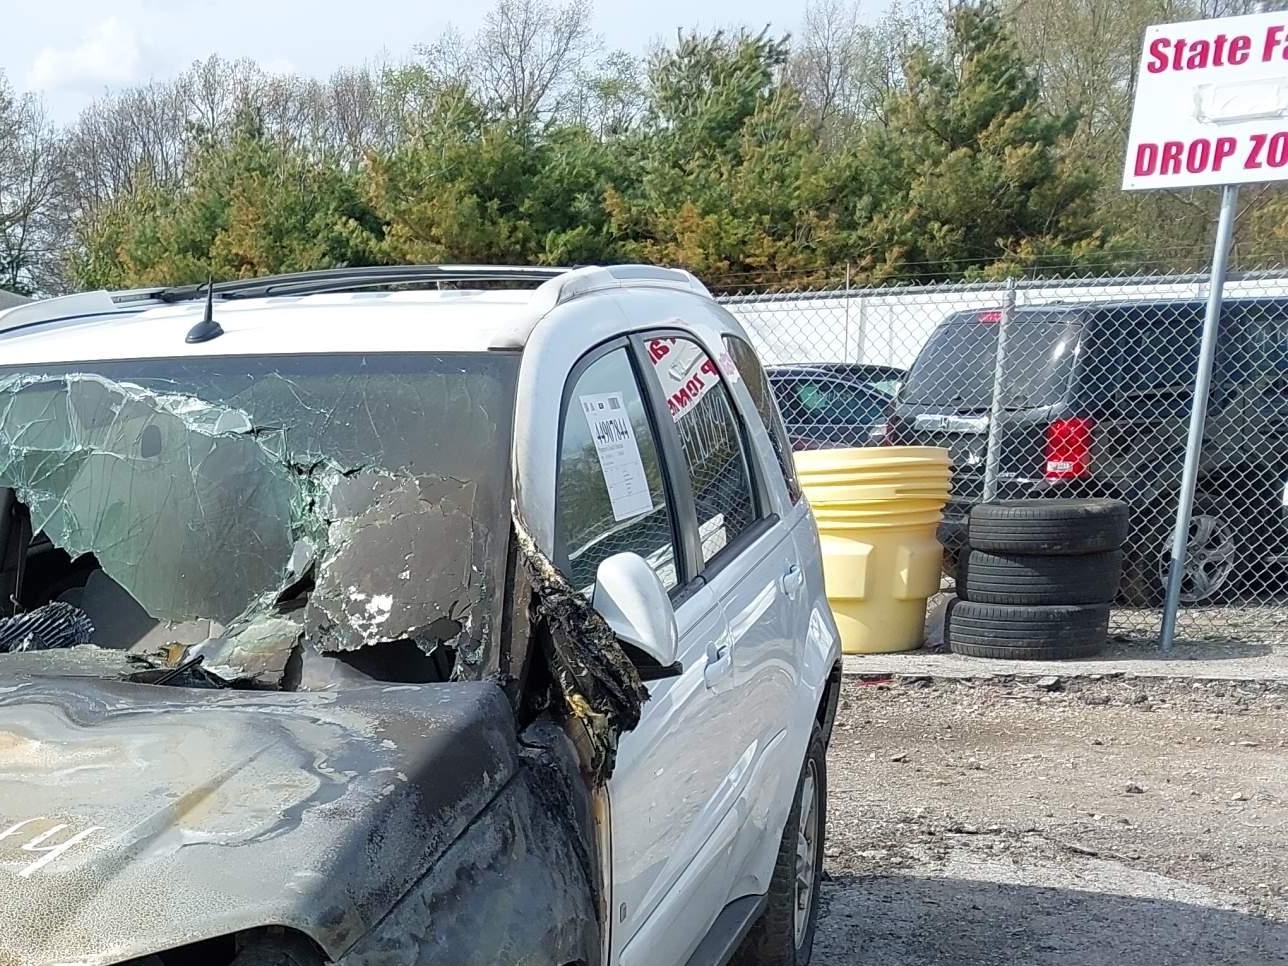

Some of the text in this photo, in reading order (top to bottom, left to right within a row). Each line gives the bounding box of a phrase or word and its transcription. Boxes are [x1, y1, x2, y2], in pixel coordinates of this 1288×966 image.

[1147, 33, 1252, 73] State
[1134, 137, 1237, 177] DROP
[594, 418, 630, 444] 44907844
